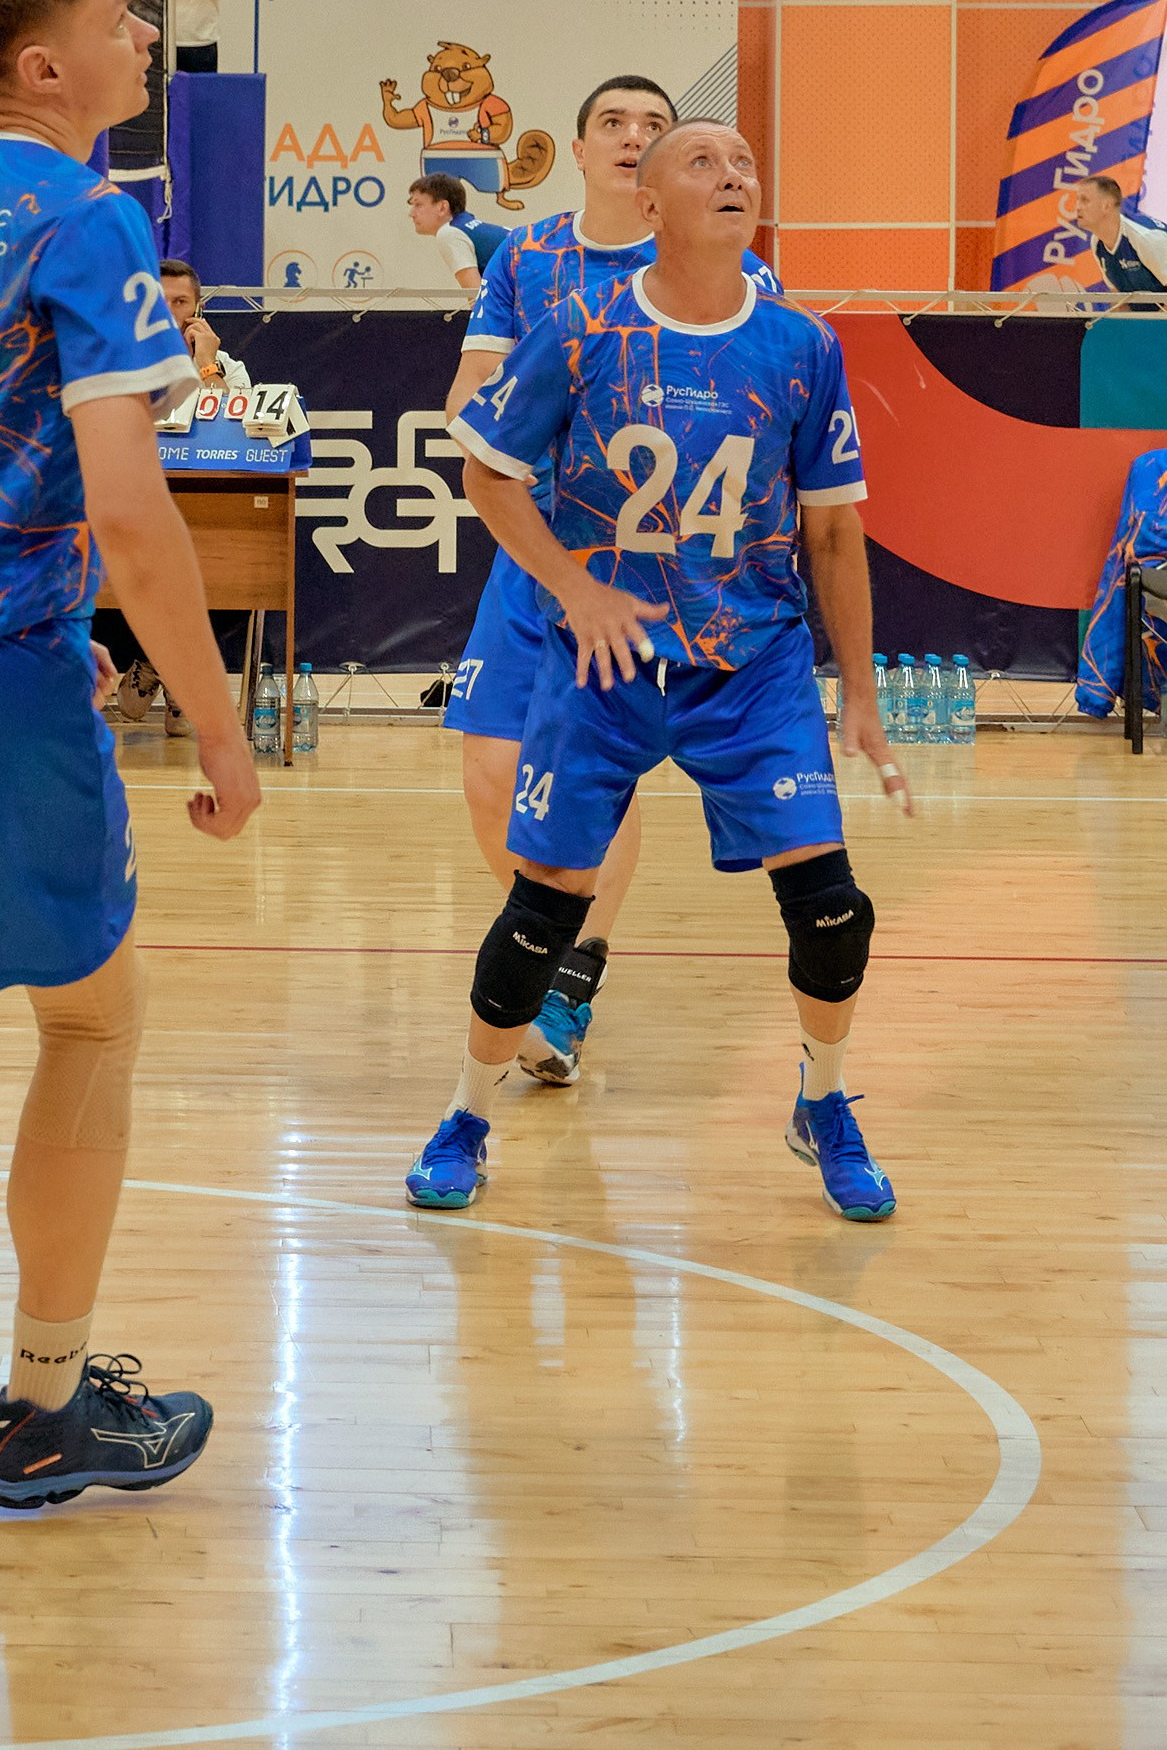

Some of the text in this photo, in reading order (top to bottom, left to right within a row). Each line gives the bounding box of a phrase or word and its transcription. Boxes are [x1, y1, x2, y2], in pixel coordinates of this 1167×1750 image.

[270, 123, 385, 169] АДА
[265, 175, 385, 212] ИДРО
[123, 271, 179, 343] 2
[199, 390, 287, 421] 0 0 14
[666, 385, 719, 400] РусГидро
[157, 447, 289, 463] OME TORRES GUEST
[828, 406, 861, 466] 2
[606, 424, 755, 558] 24
[451, 658, 484, 700] 27
[515, 763, 554, 821] 24
[20, 1341, 87, 1364] Reeb
